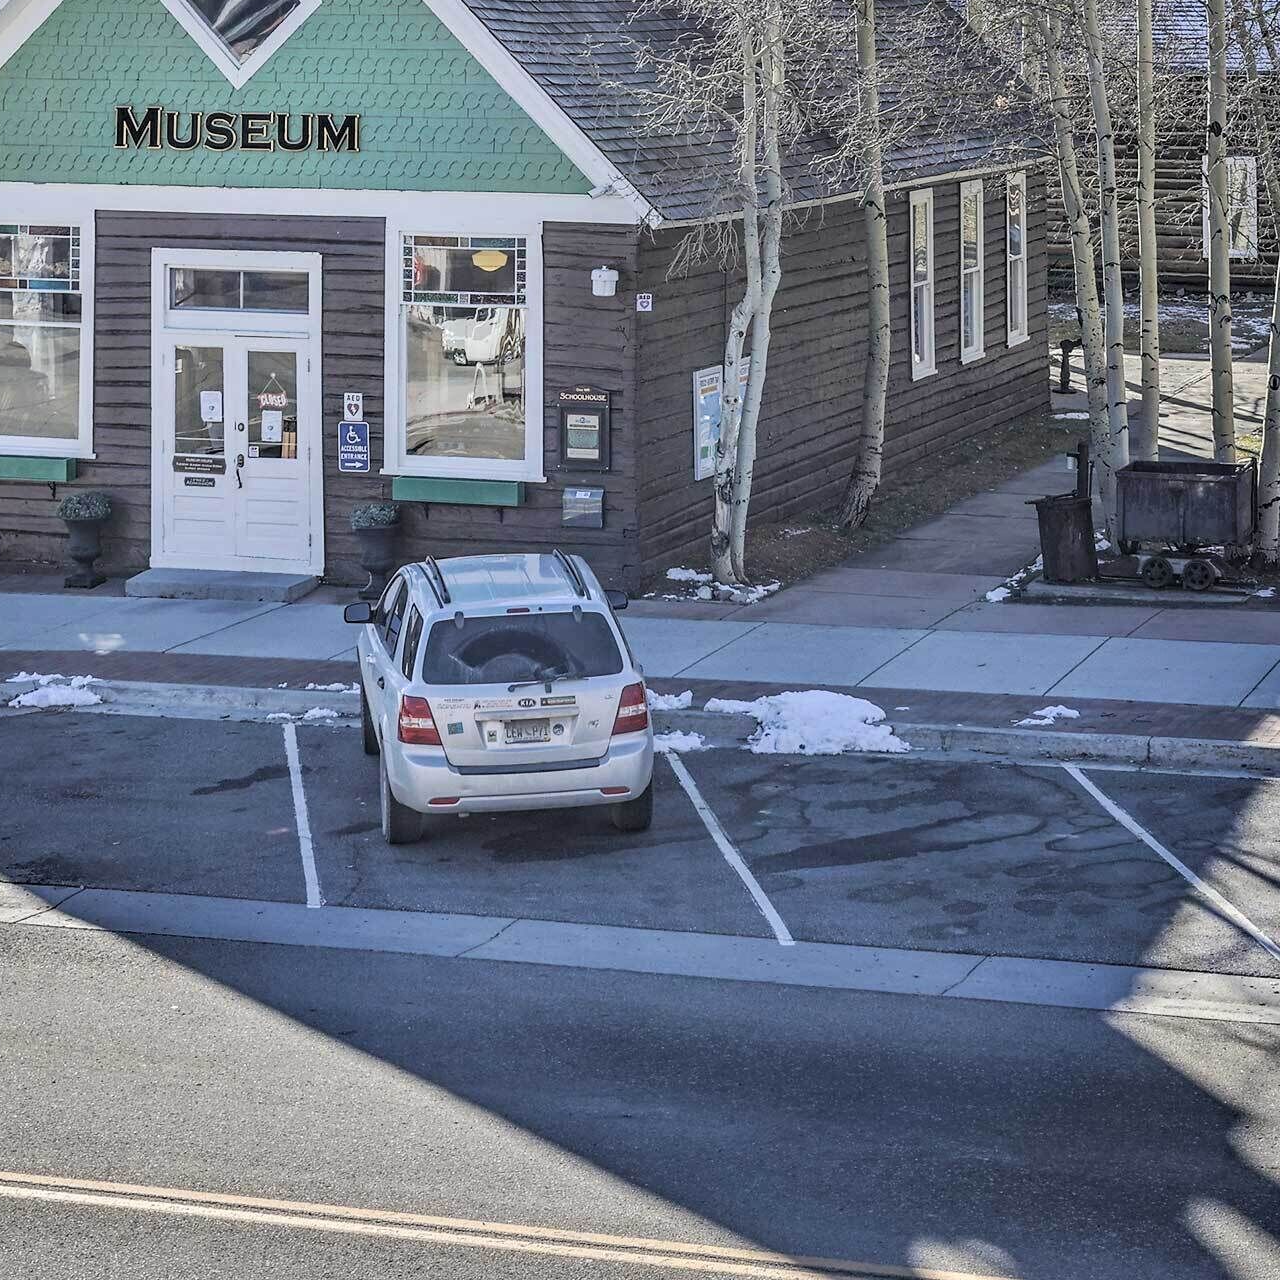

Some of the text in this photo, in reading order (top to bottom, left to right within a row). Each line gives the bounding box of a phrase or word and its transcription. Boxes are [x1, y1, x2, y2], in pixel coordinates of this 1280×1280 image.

[113, 105, 361, 153] MUSEUM
[260, 393, 287, 407] CLOSED
[346, 394, 361, 402] AED
[560, 392, 608, 402] SCHOOLHOUSE
[340, 445, 368, 453] ACCESSIBLE
